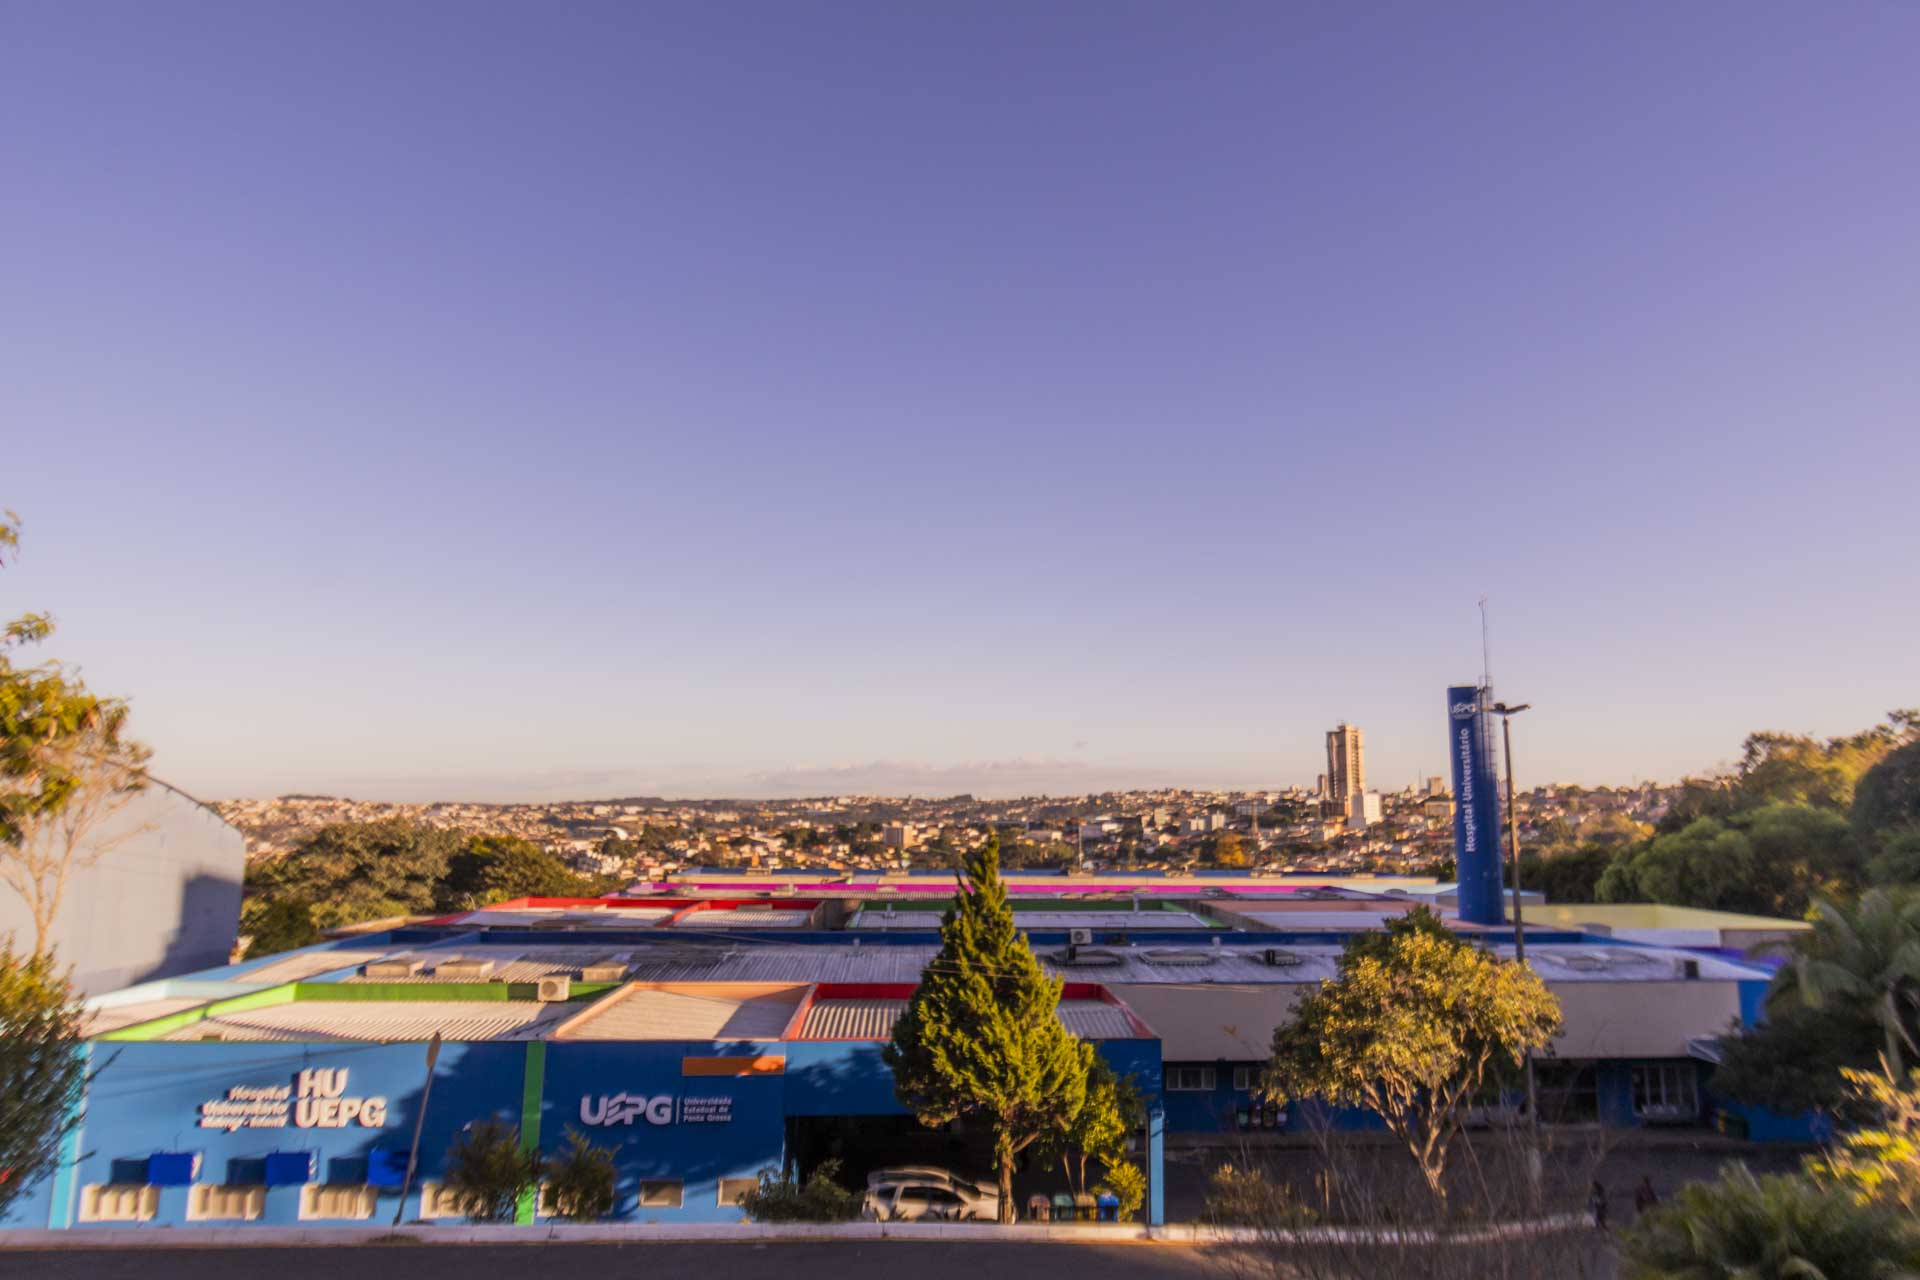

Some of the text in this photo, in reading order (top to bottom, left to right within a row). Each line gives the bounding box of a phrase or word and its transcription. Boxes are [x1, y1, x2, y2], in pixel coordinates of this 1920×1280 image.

[1459, 728, 1473, 802] Universitário
[1462, 803, 1477, 853] Hospital
[298, 1068, 349, 1097] HU
[296, 1096, 387, 1128] UEPG
[580, 1092, 672, 1126] UEPG
[684, 1096, 732, 1105] Universidade
[684, 1105, 729, 1113] Estadual de
[683, 1113, 732, 1122] Ponta Grossa
